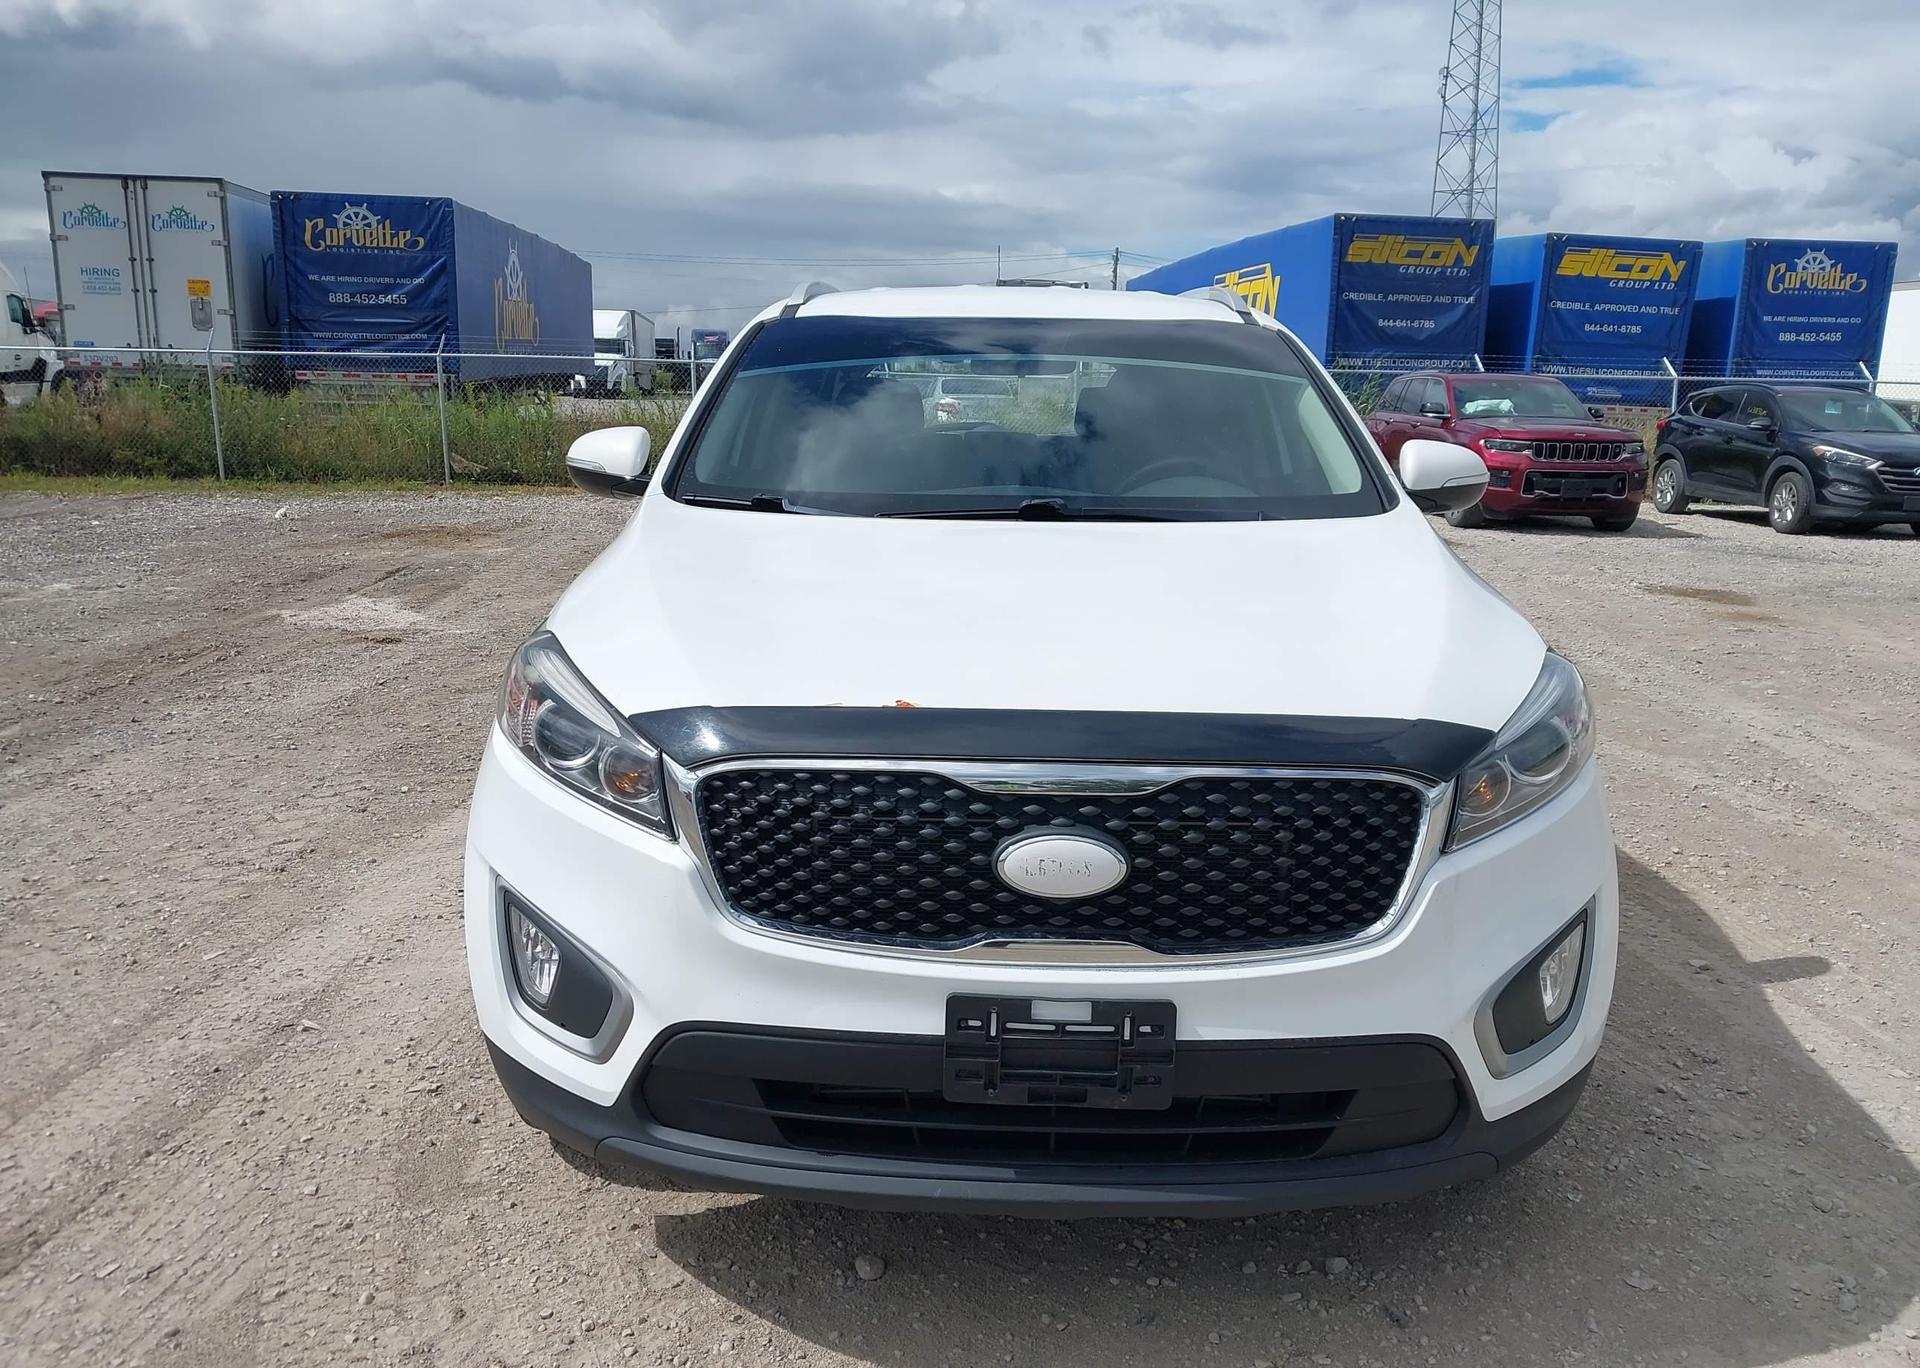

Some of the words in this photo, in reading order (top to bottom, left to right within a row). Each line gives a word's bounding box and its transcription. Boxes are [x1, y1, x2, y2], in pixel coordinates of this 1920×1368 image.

[62, 210, 127, 229] Corvette
[151, 213, 215, 232] Corvette
[304, 218, 425, 251] Corvette
[80, 267, 121, 277] HIRING
[1399, 265, 1441, 275] GROUP
[1446, 269, 1471, 277] LTD.
[1766, 262, 1868, 294] Corvette
[1609, 279, 1651, 289] GROUP
[1654, 281, 1678, 290] LTD.
[328, 292, 407, 304] 888-452-5455
[1342, 292, 1386, 302] CREDIBLE,
[1387, 294, 1432, 303] APPROVED
[1433, 296, 1452, 304] AND
[1453, 296, 1476, 304] TRUE
[1550, 300, 1593, 311] CREDIBLE,
[1594, 303, 1639, 313] APPROVED
[1640, 306, 1658, 314] AND
[1660, 307, 1681, 315] TRUE
[1378, 318, 1435, 328] 844-641-8785
[1584, 323, 1642, 334] 844-641-8785
[1778, 332, 1842, 342] 888-452-5455
[1756, 369, 1855, 377] WWW.CORVETTELOGISTICS.COM
